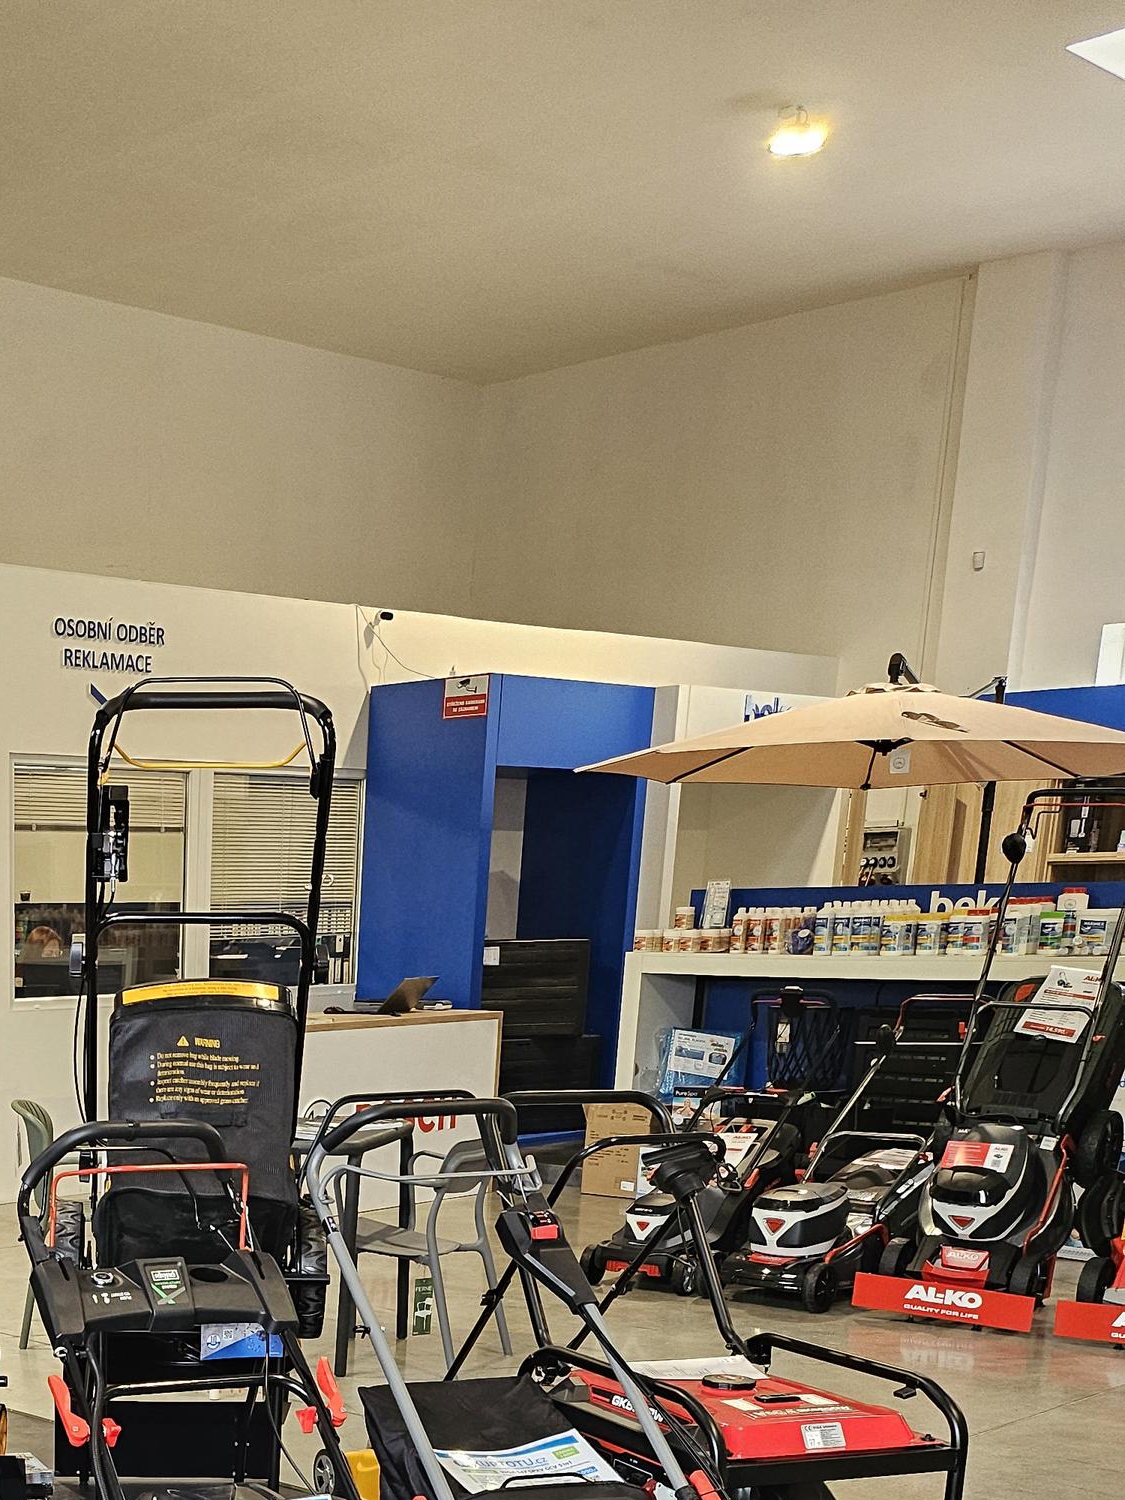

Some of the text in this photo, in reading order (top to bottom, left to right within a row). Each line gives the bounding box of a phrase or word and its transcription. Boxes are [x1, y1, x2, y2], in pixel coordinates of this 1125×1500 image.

[54, 617, 165, 645] OSOBNÍ ODBĚR
[64, 649, 152, 673] REKLAMACE
[903, 1303, 939, 1313] QUALITY
[904, 1284, 983, 1308] AL-KO
